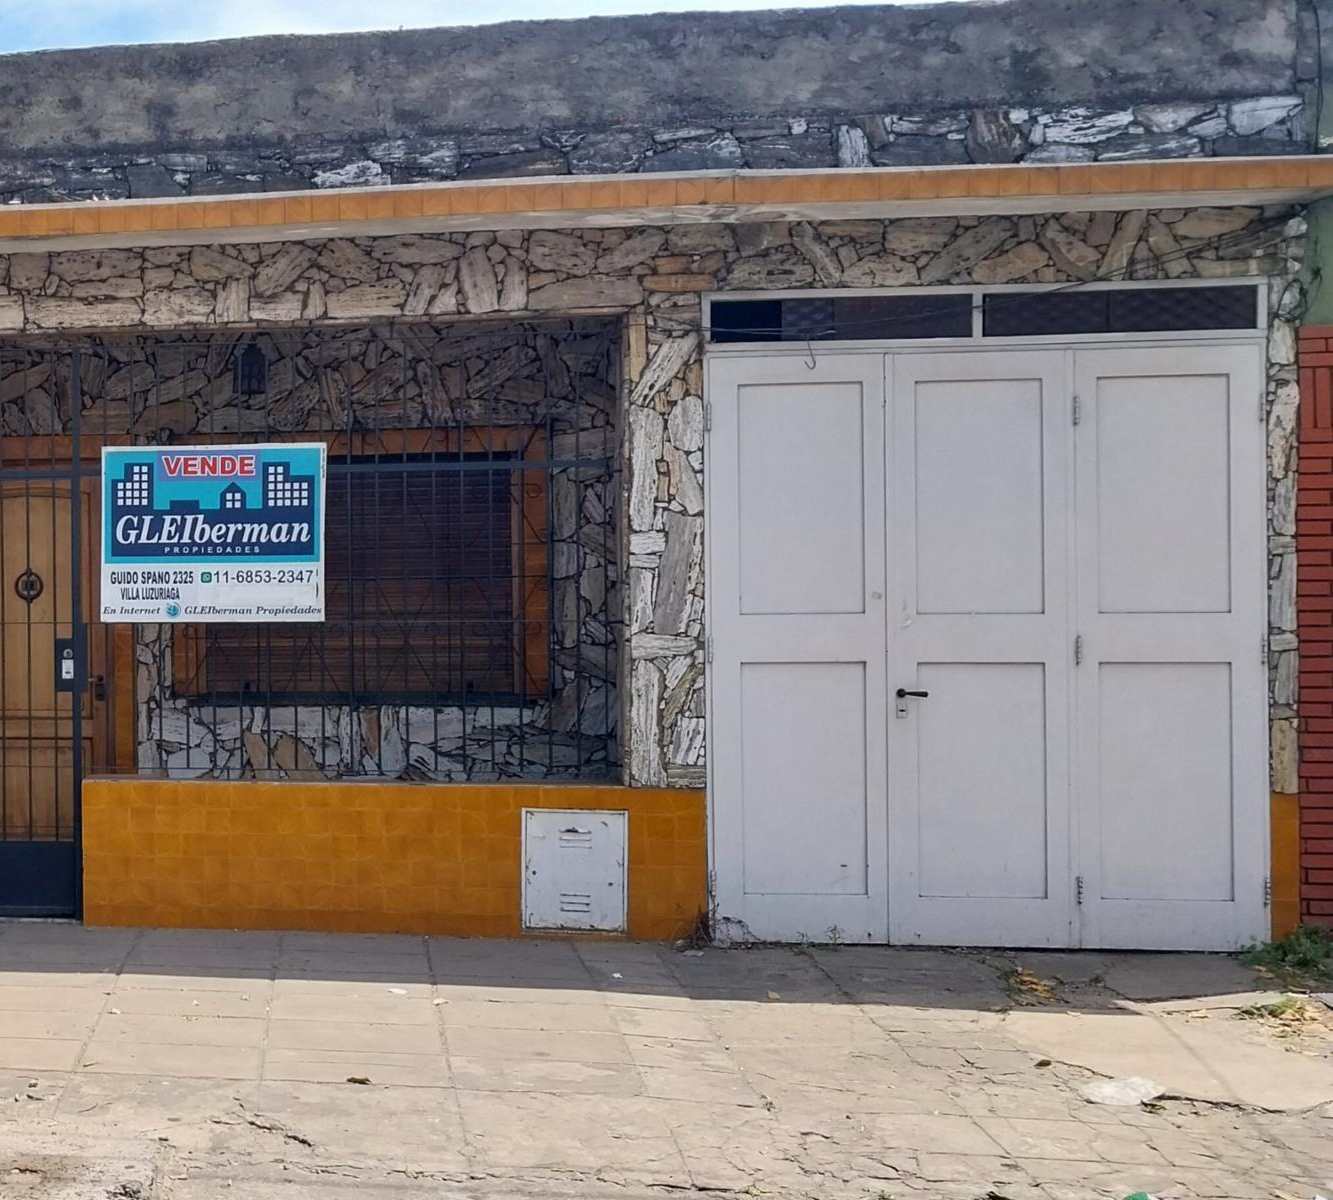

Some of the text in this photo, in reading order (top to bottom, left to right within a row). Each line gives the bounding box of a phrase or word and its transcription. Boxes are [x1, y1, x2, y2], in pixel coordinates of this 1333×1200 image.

[163, 455, 255, 477] VENDE
[115, 513, 311, 545] GLEIberman
[110, 570, 194, 584] GUIDO SPANO 2325
[213, 570, 314, 583] 11-6853-2347
[120, 588, 180, 600] VILLA LUZURIAGA
[103, 605, 322, 616] En Internet GLEIberman Propiedades
